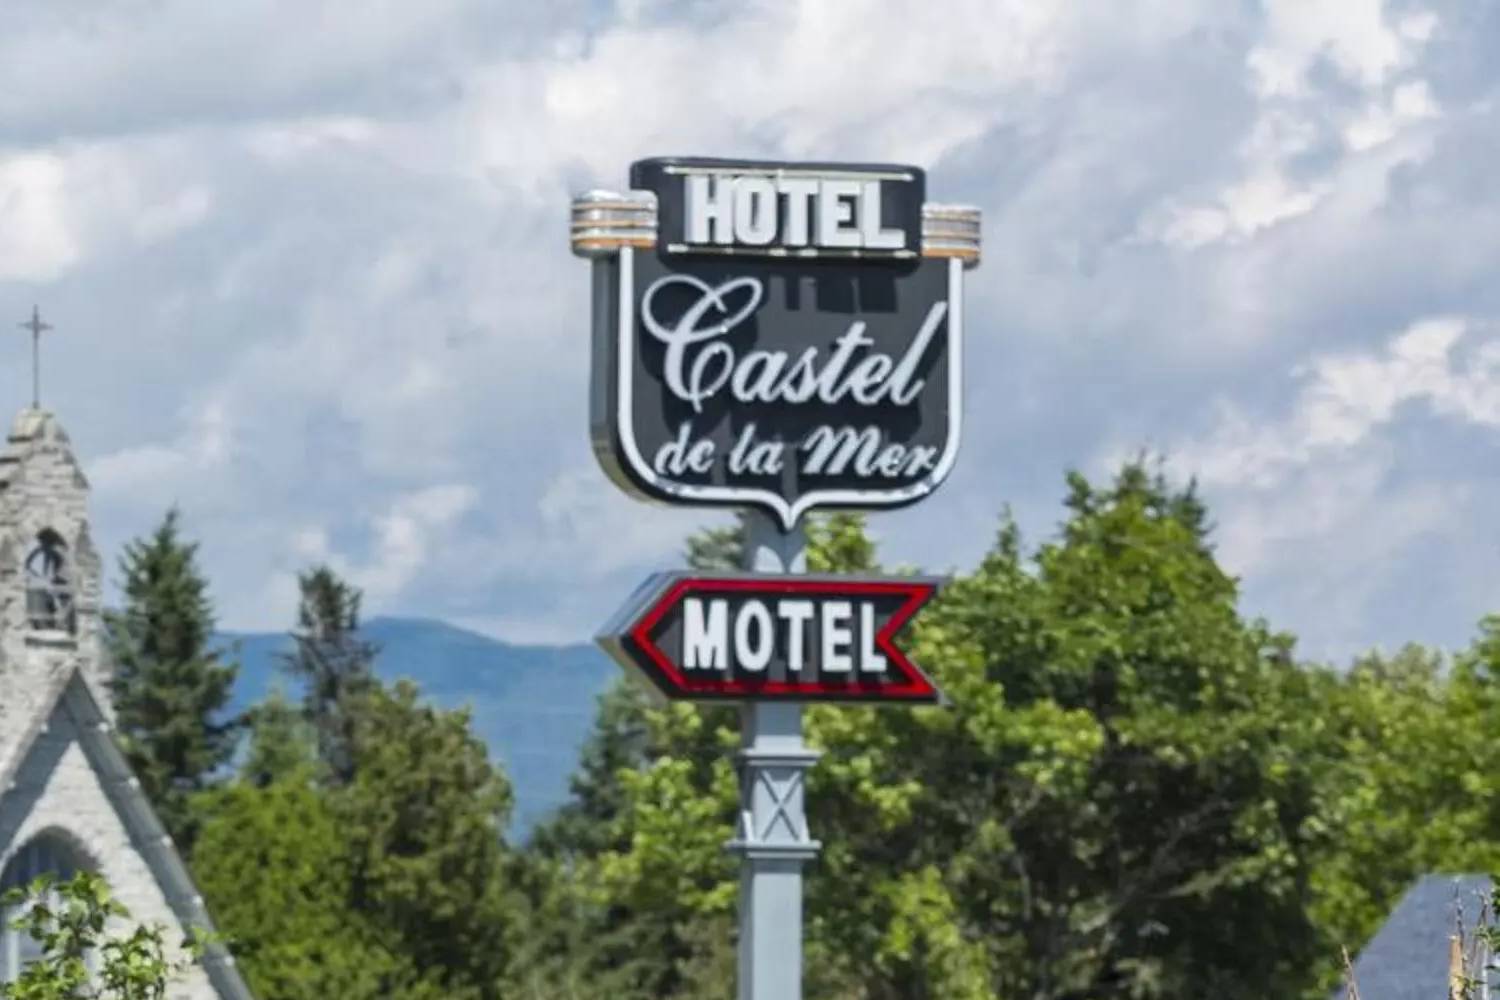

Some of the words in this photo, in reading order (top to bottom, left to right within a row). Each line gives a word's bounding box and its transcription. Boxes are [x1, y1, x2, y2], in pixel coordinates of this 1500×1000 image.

[684, 173, 906, 249] HOTEL
[642, 274, 948, 414] Castel
[654, 423, 716, 476] de
[728, 423, 785, 475] la
[802, 424, 938, 478] Mer
[682, 597, 887, 672] MOTEL
